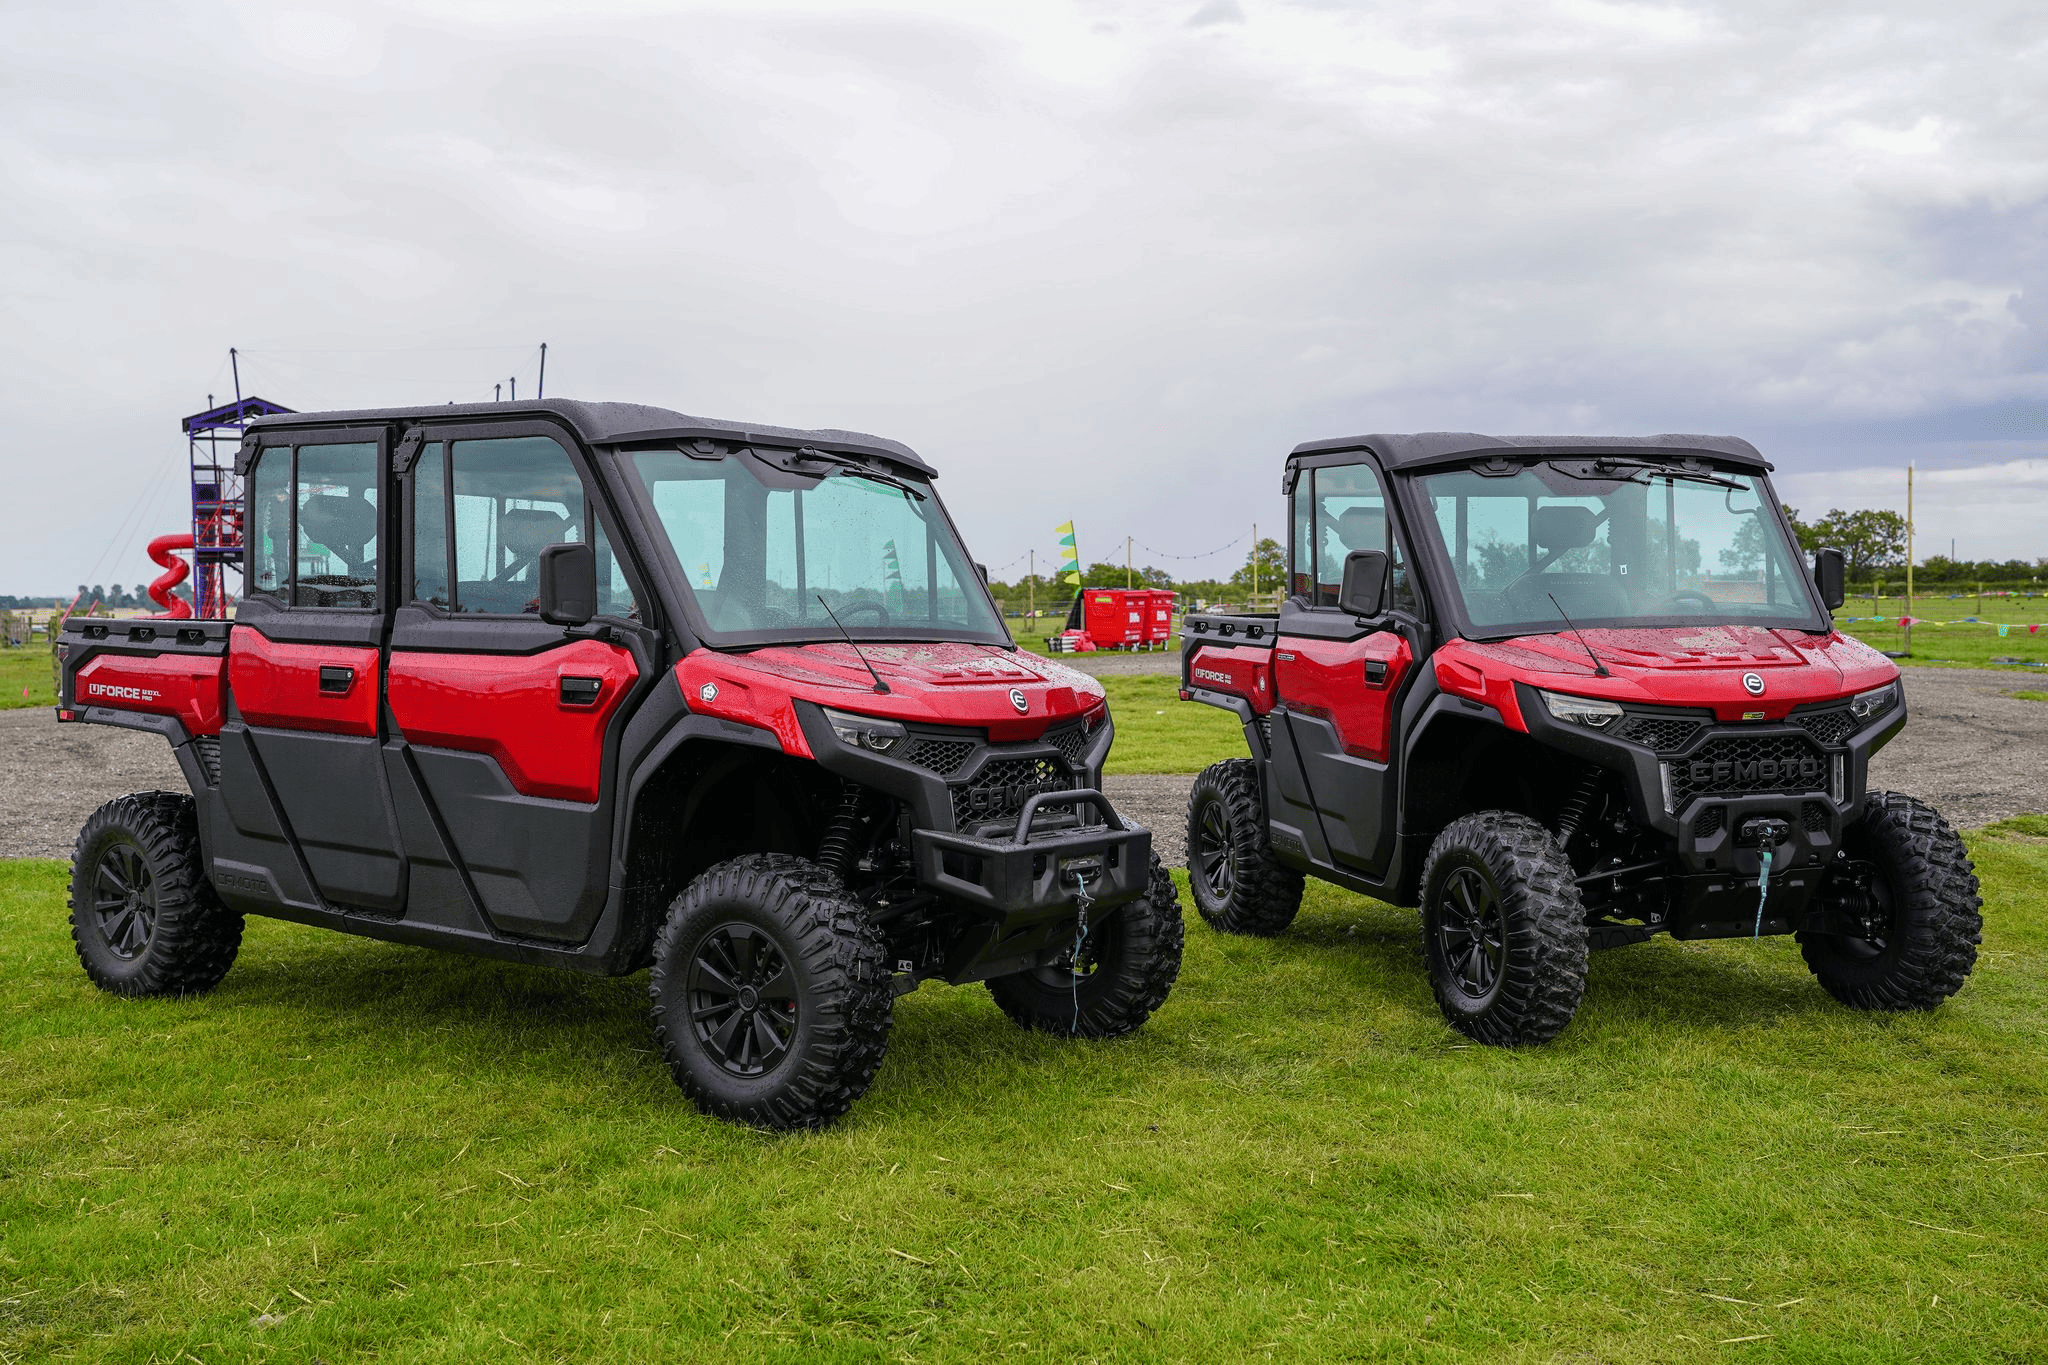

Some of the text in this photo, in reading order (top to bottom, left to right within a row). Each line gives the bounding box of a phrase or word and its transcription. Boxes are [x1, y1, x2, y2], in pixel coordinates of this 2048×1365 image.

[1195, 668, 1225, 683] UFORCE
[89, 683, 141, 700] UFORCE
[1690, 758, 1818, 782] CFMOTO
